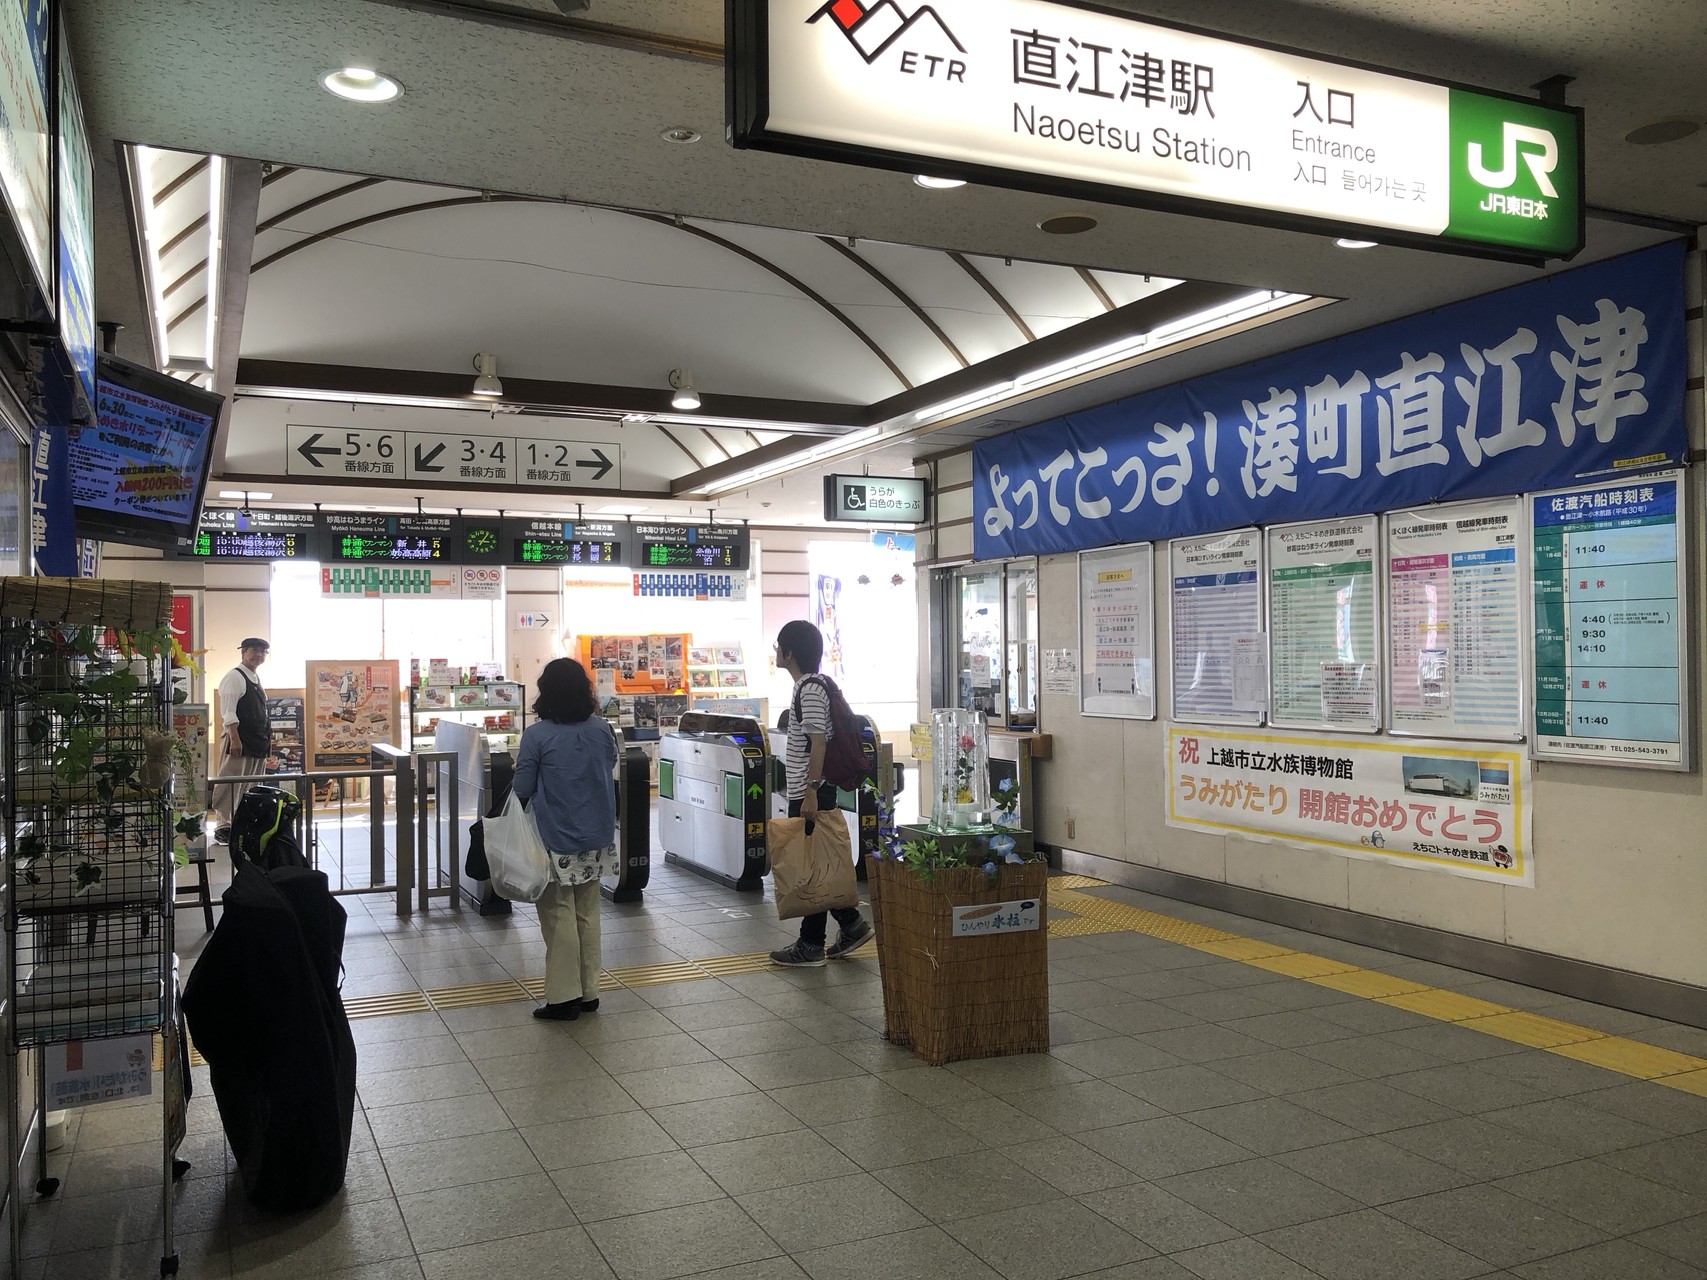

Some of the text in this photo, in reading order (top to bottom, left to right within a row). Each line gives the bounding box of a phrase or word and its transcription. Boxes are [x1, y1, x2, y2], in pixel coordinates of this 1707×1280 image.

[900, 51, 967, 83] ETR
[1010, 29, 1216, 119] 直江津駅
[1293, 81, 1355, 128] 入口
[1013, 102, 1251, 171] Naoetsu Station
[1292, 129, 1376, 163] Entrance
[1468, 121, 1559, 198] JR
[1293, 161, 1327, 186] 入口
[1341, 169, 1427, 202] 들어가는 곳
[1480, 193, 1549, 220] JR東日本
[344, 459, 394, 474] 番線方面
[459, 465, 506, 479] 番線方面
[526, 469, 571, 482] 番線方面
[869, 486, 895, 497] うらが
[869, 498, 920, 509] 白色のきっぷ
[1552, 487, 1654, 512] 佐渡汽船時刻表
[201, 511, 235, 521] くほく線
[326, 515, 386, 525] 妙高はねうまライン
[531, 522, 562, 531] 信越本線
[636, 526, 687, 535] 日本海ひすいライン
[1392, 516, 1508, 536] ほくほく線発車時刻表 信越線発車時刻表
[1295, 526, 1363, 540] えちごトキめき鉄道株式会社
[1495, 534, 1515, 542] 直江津駅
[432, 540, 441, 548] 5
[1286, 539, 1355, 553] 妙高はねうまライン発車時刻表
[1576, 545, 1606, 554] 11:40
[432, 549, 441, 558] 4
[1582, 615, 1606, 624] 4:40
[1582, 630, 1606, 638] 9:30
[1577, 644, 1606, 653] 14:10
[270, 705, 298, 718] 崎屋
[1578, 716, 1609, 725] 11:40
[1624, 746, 1668, 755] 025-543-3791
[1179, 737, 1354, 780] 祝 上越市立水族博物館
[1480, 791, 1510, 800] うみがたり
[1180, 775, 1502, 844] うみがたり 開館おめでとう
[1412, 842, 1489, 862] えちごトキめき鉄道
